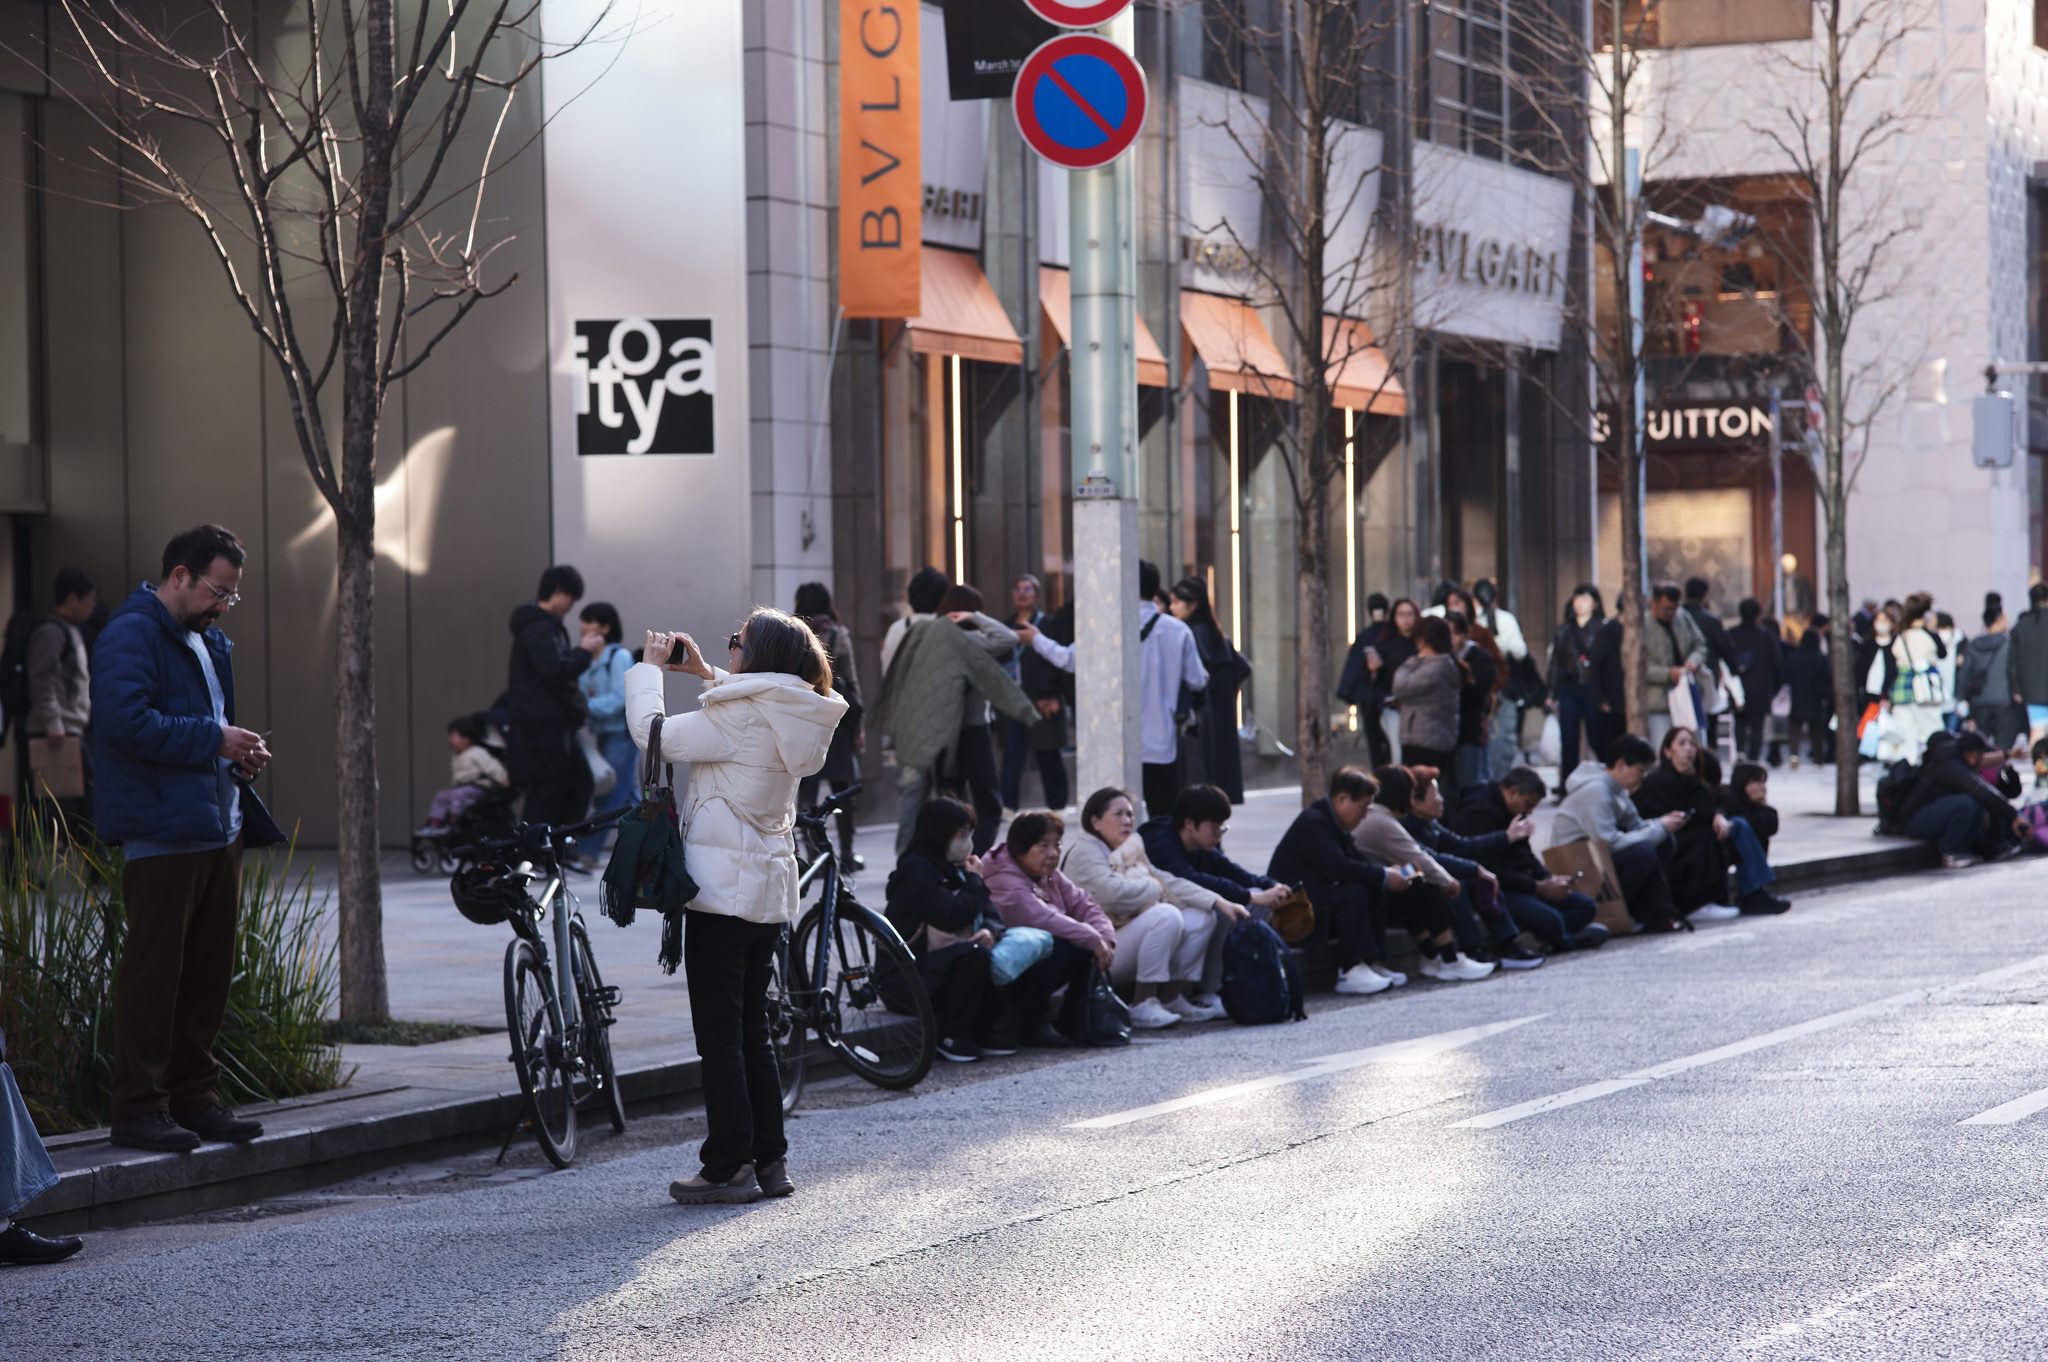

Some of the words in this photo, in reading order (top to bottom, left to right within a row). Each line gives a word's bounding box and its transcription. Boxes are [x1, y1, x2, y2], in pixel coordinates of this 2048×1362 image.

[974, 58, 1008, 71] March
[860, 4, 902, 251] BVLG
[1647, 405, 1774, 441] UITTON
